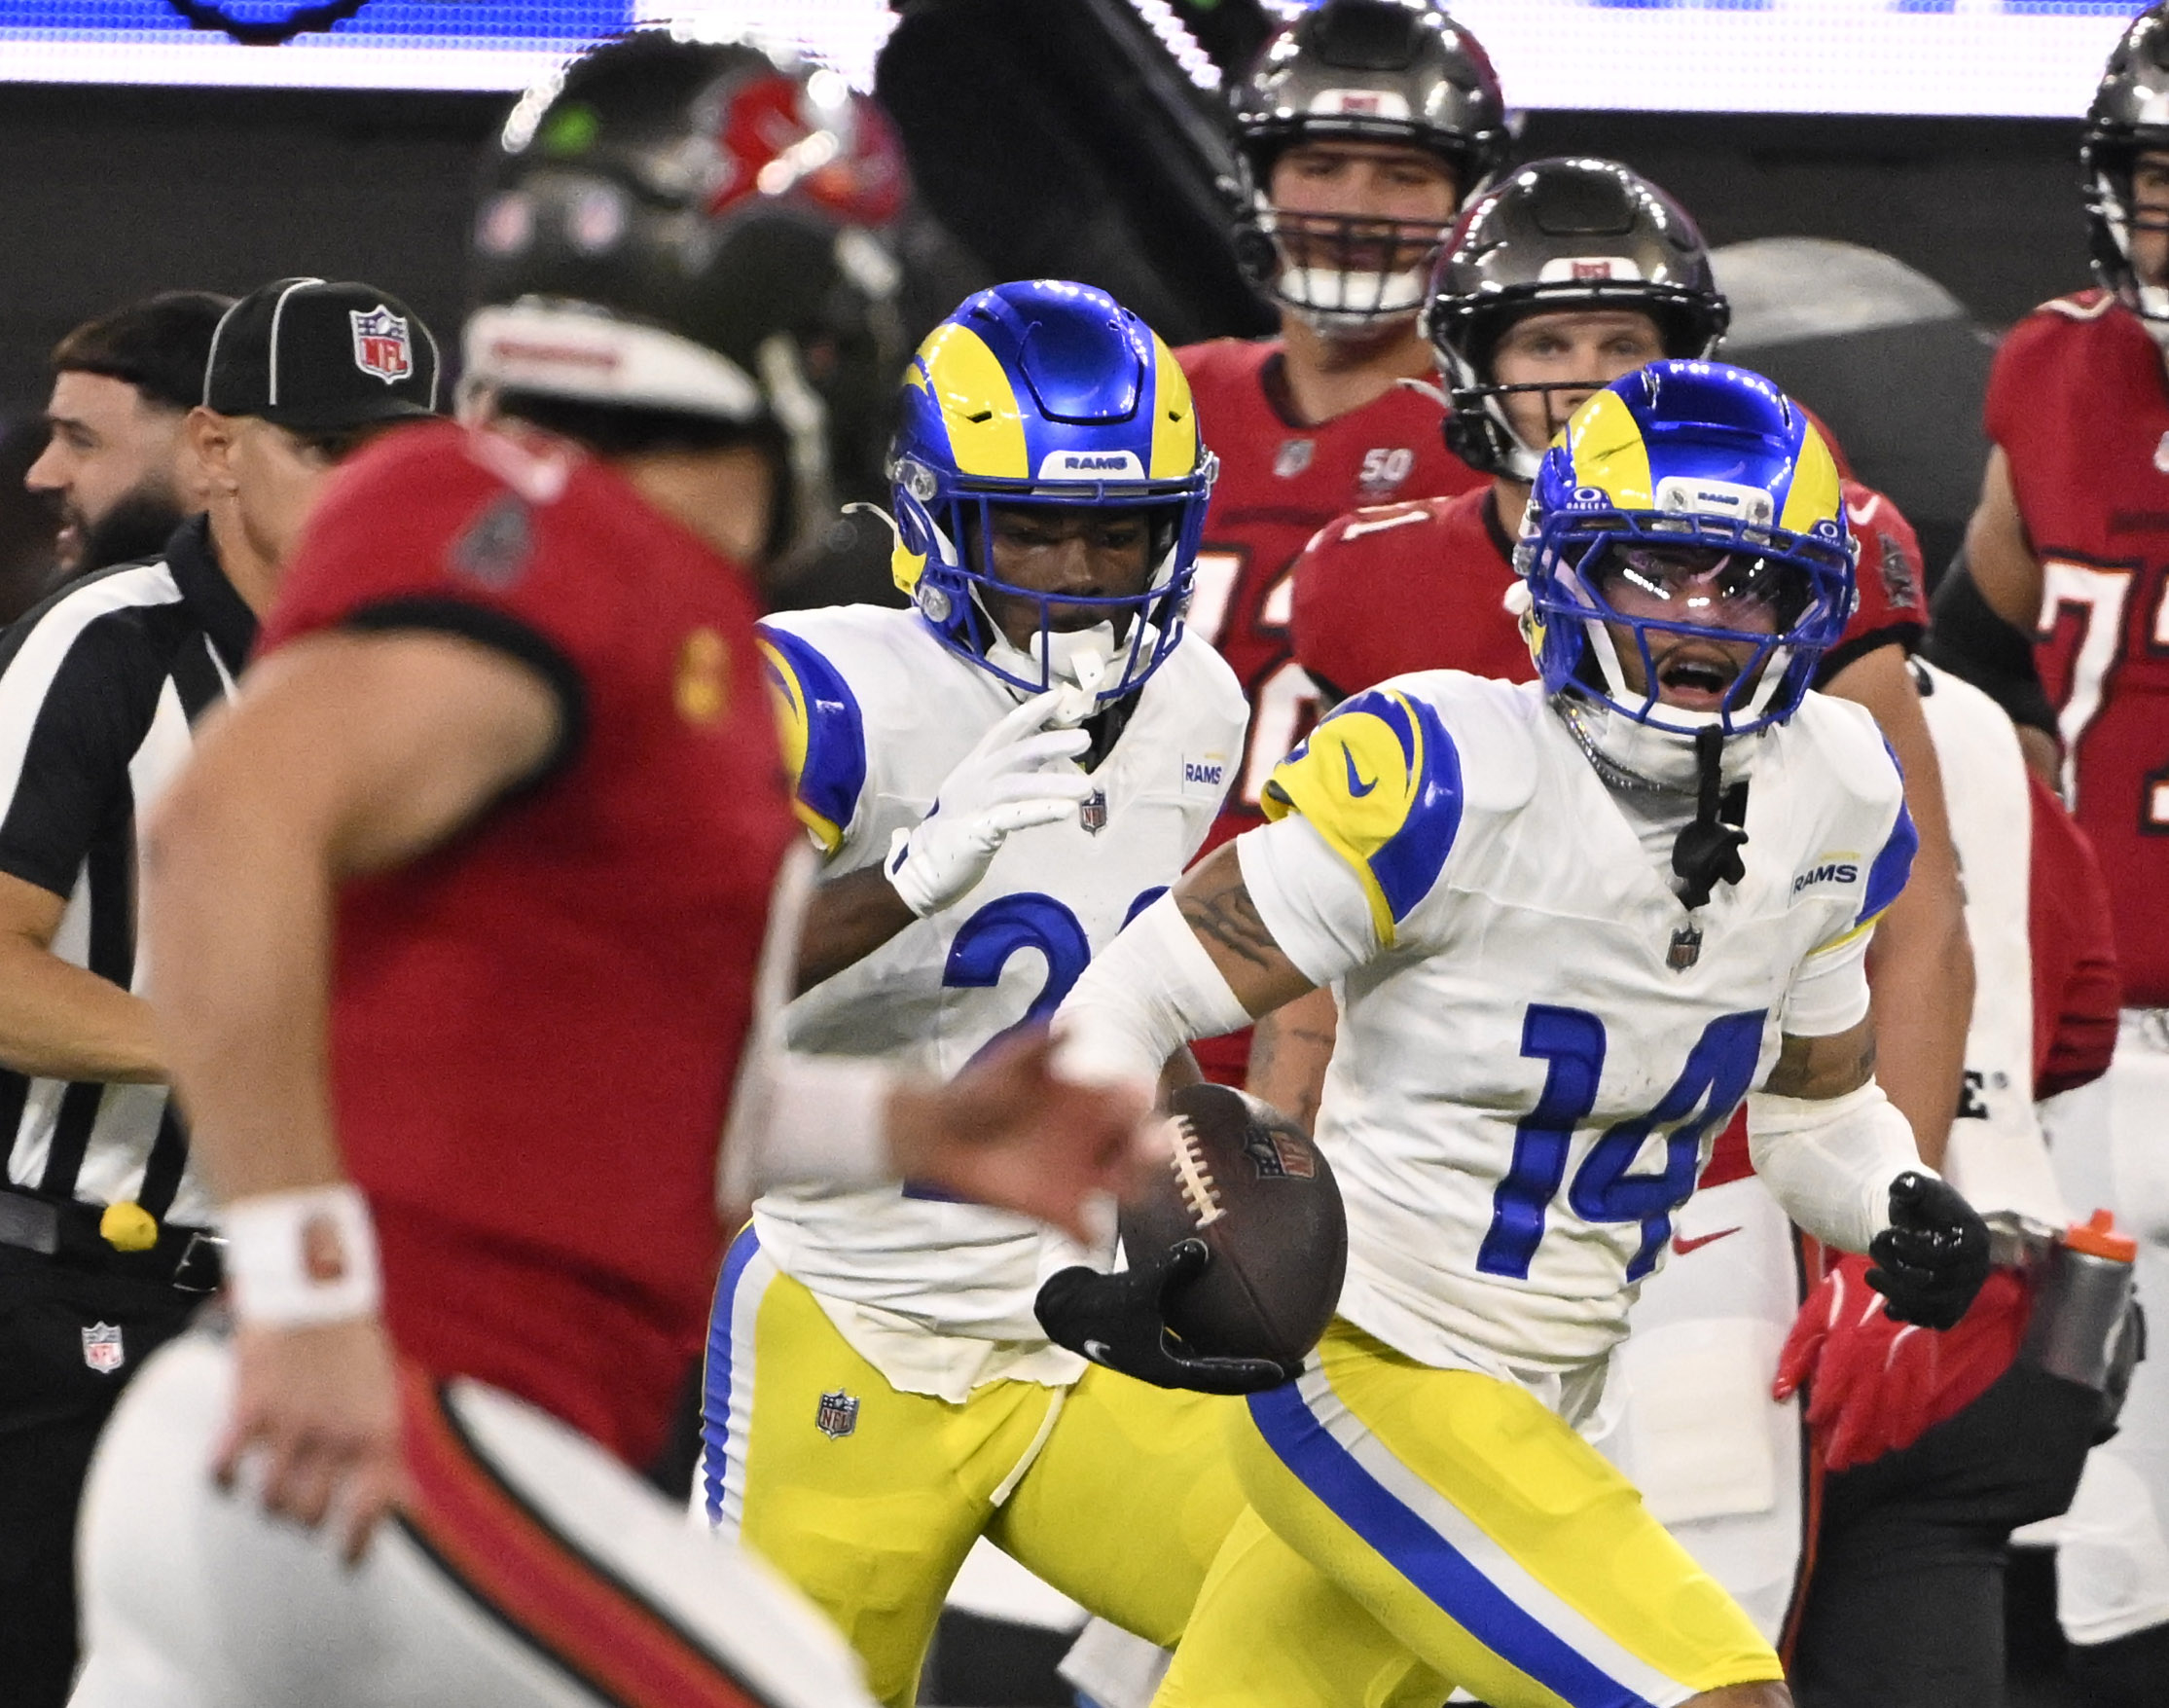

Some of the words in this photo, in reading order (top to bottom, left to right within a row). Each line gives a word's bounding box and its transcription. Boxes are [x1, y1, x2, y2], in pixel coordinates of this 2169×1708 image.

[360, 336, 408, 372] NFL
[1065, 456, 1128, 470] RAMS
[1360, 448, 1414, 482] 50
[2038, 560, 2169, 823] 7
[1185, 763, 1222, 785] RAMS
[1792, 864, 1859, 894] RAMS
[1475, 1002, 1769, 1284] 14
[821, 1408, 849, 1431] NFL
